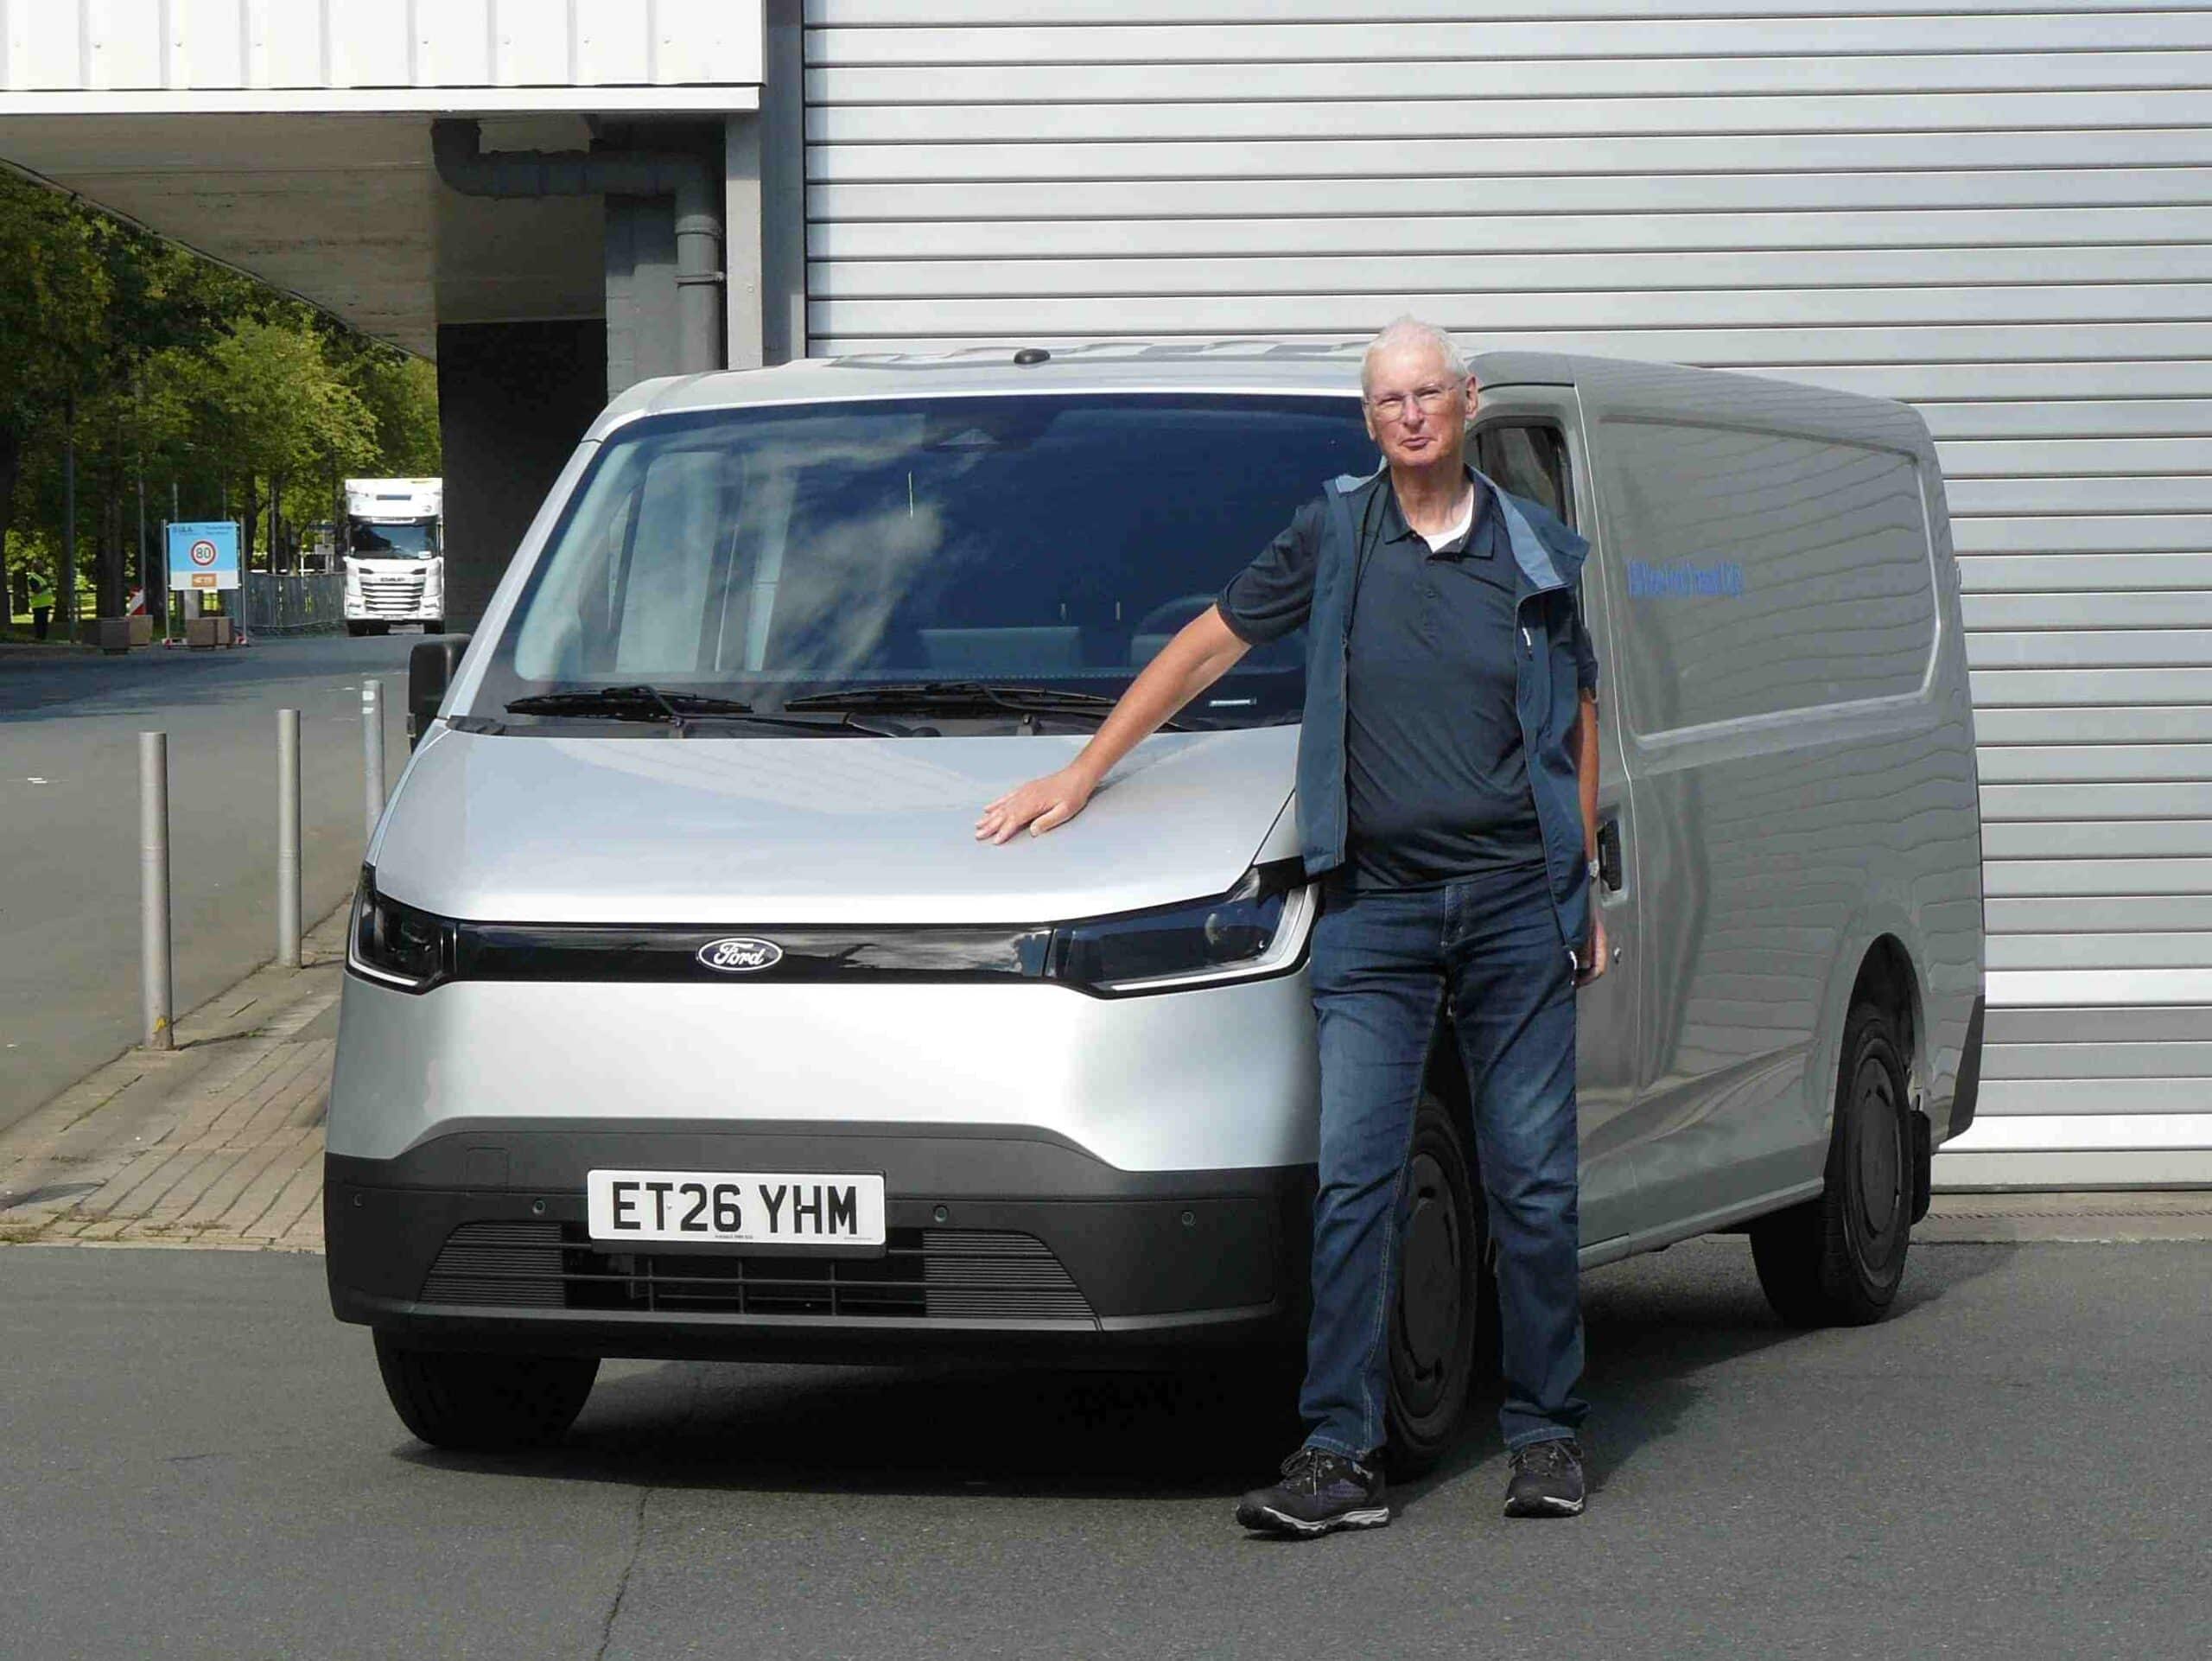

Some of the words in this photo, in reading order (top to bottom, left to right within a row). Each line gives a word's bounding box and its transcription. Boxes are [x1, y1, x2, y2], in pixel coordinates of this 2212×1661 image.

[195, 547, 212, 558] 80
[714, 942, 766, 965] Ford
[613, 1181, 741, 1232] ET26
[759, 1184, 857, 1235] YHM
